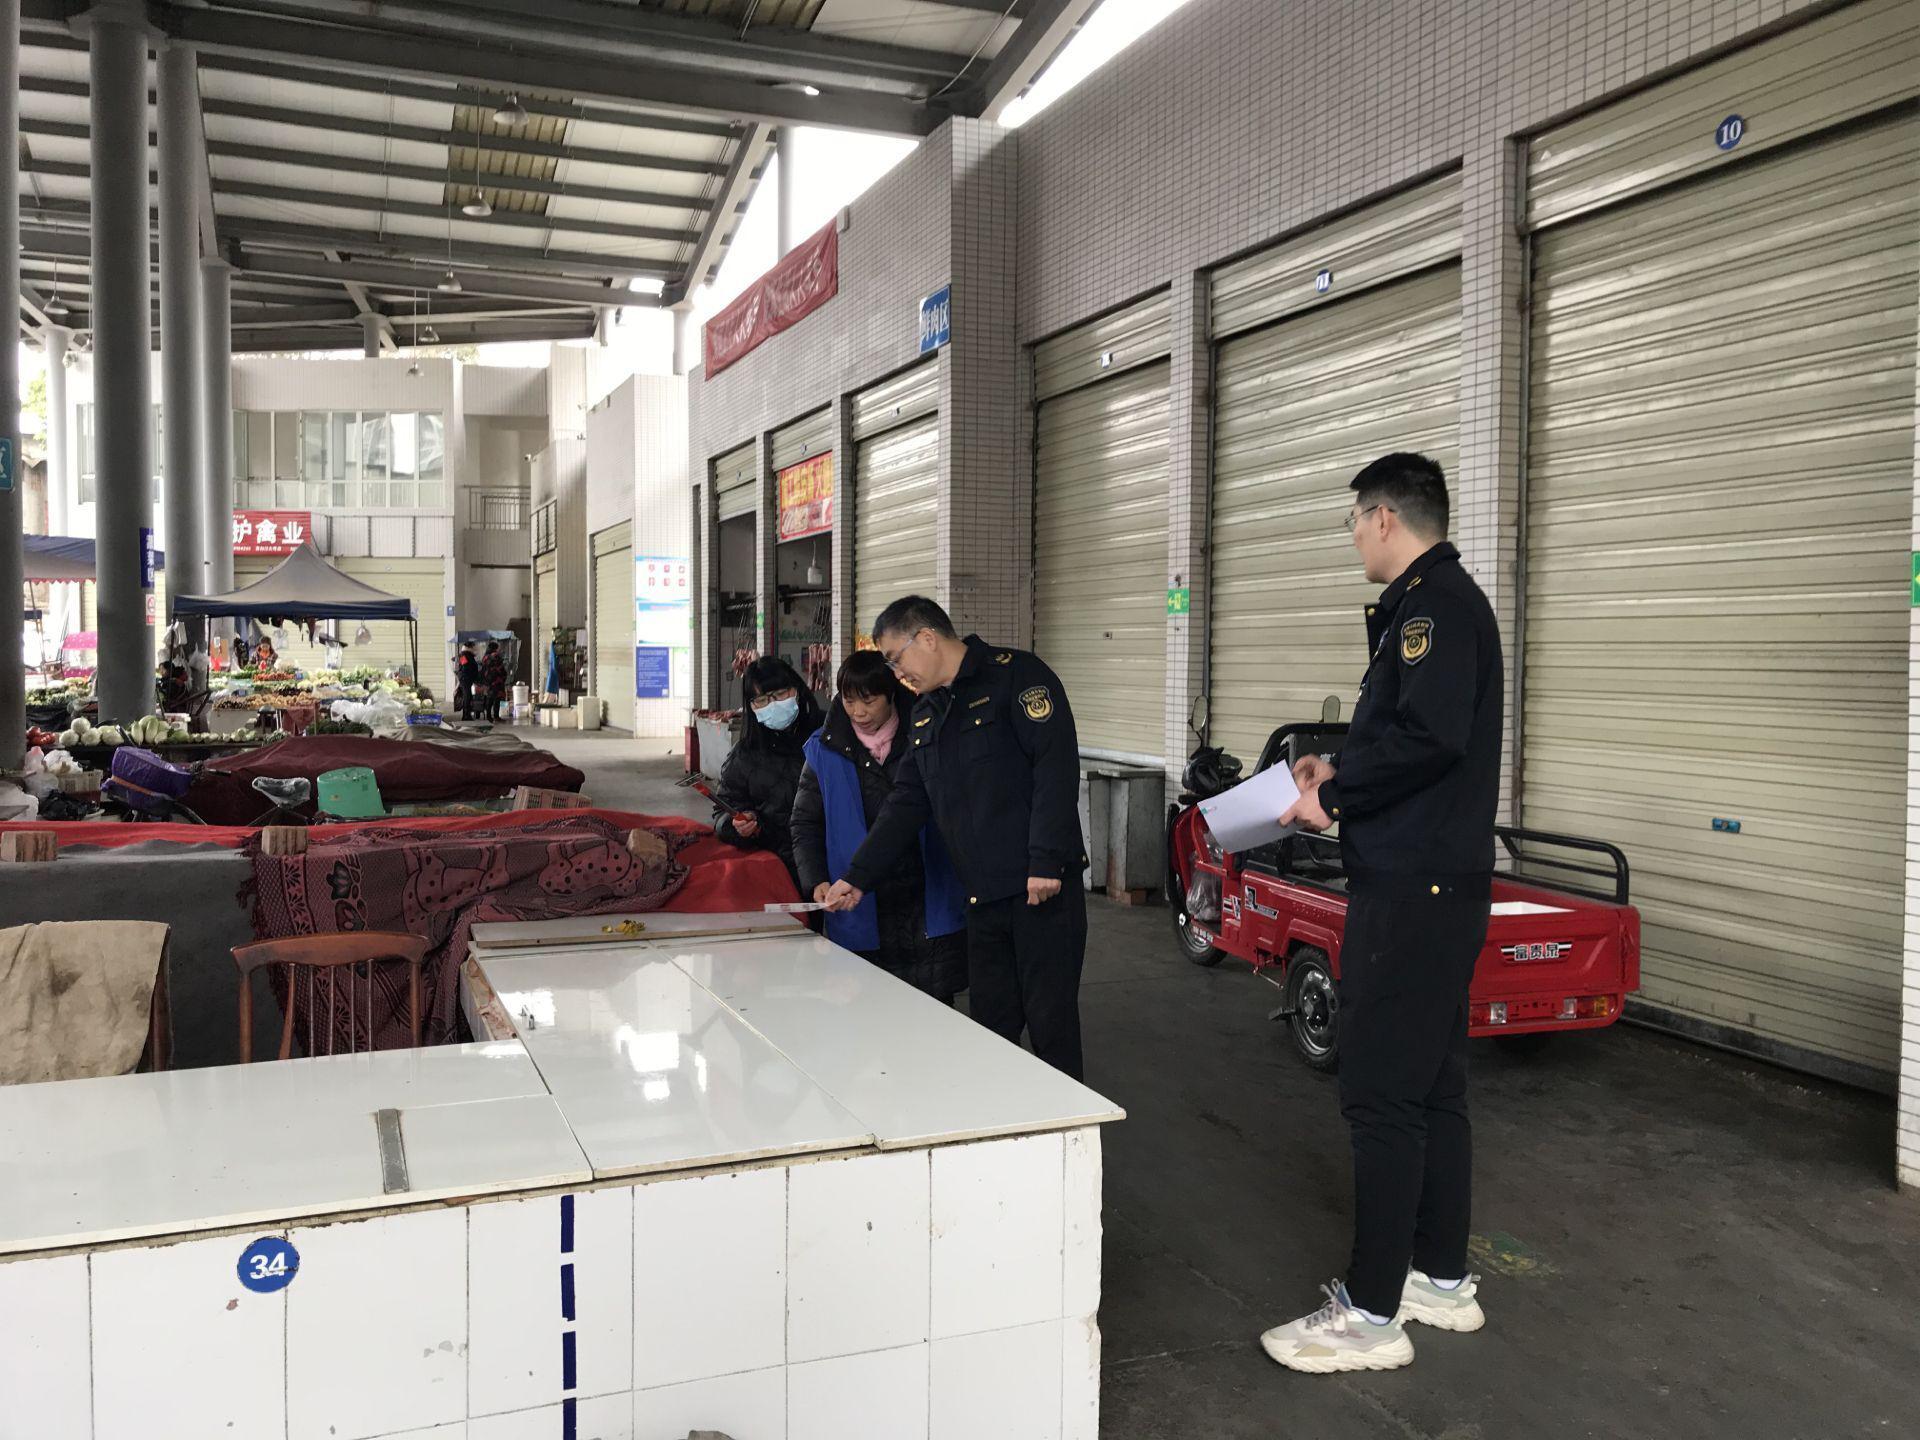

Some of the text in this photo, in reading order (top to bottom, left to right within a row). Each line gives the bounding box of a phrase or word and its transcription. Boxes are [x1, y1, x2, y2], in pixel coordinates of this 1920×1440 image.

[1720, 120, 1742, 146] 10
[920, 299, 949, 341] 鲜肉区
[232, 518, 304, 544] 护禽业
[249, 1251, 289, 1280] 34
